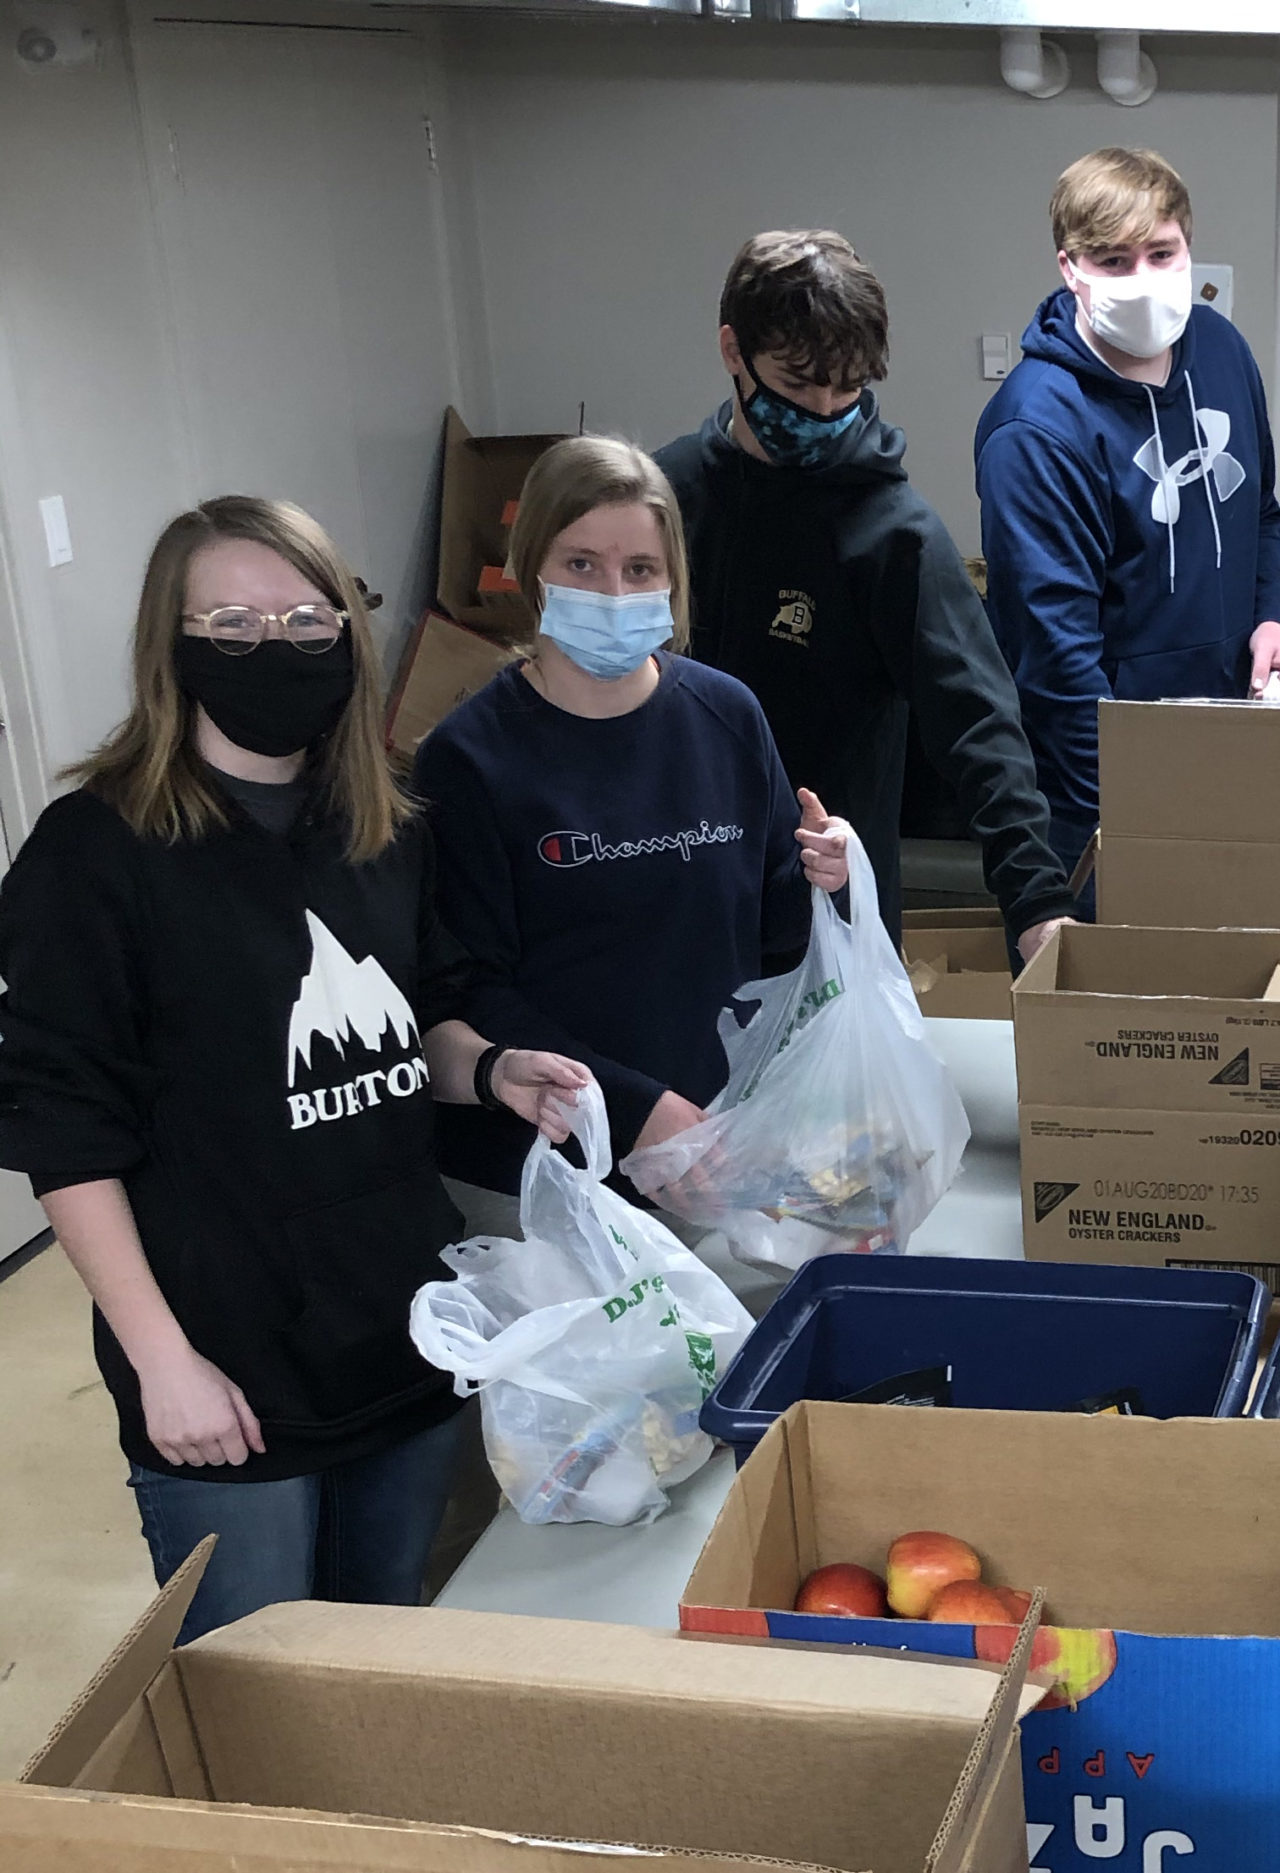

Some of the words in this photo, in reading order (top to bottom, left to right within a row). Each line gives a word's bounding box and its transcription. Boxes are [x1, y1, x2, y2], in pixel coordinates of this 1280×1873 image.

[537, 818, 744, 868] Champion
[1117, 1030, 1175, 1041] CRACKERS
[1177, 1031, 1219, 1043] OYSTER
[1096, 1041, 1176, 1059] ENGLAND
[1180, 1044, 1219, 1060] NEW
[287, 1053, 430, 1130] BURTON
[1069, 1209, 1110, 1227] NEW
[1117, 1211, 1205, 1231] ENGLAND
[1068, 1228, 1115, 1241] OYSTER
[1118, 1230, 1181, 1243] CRACKERS
